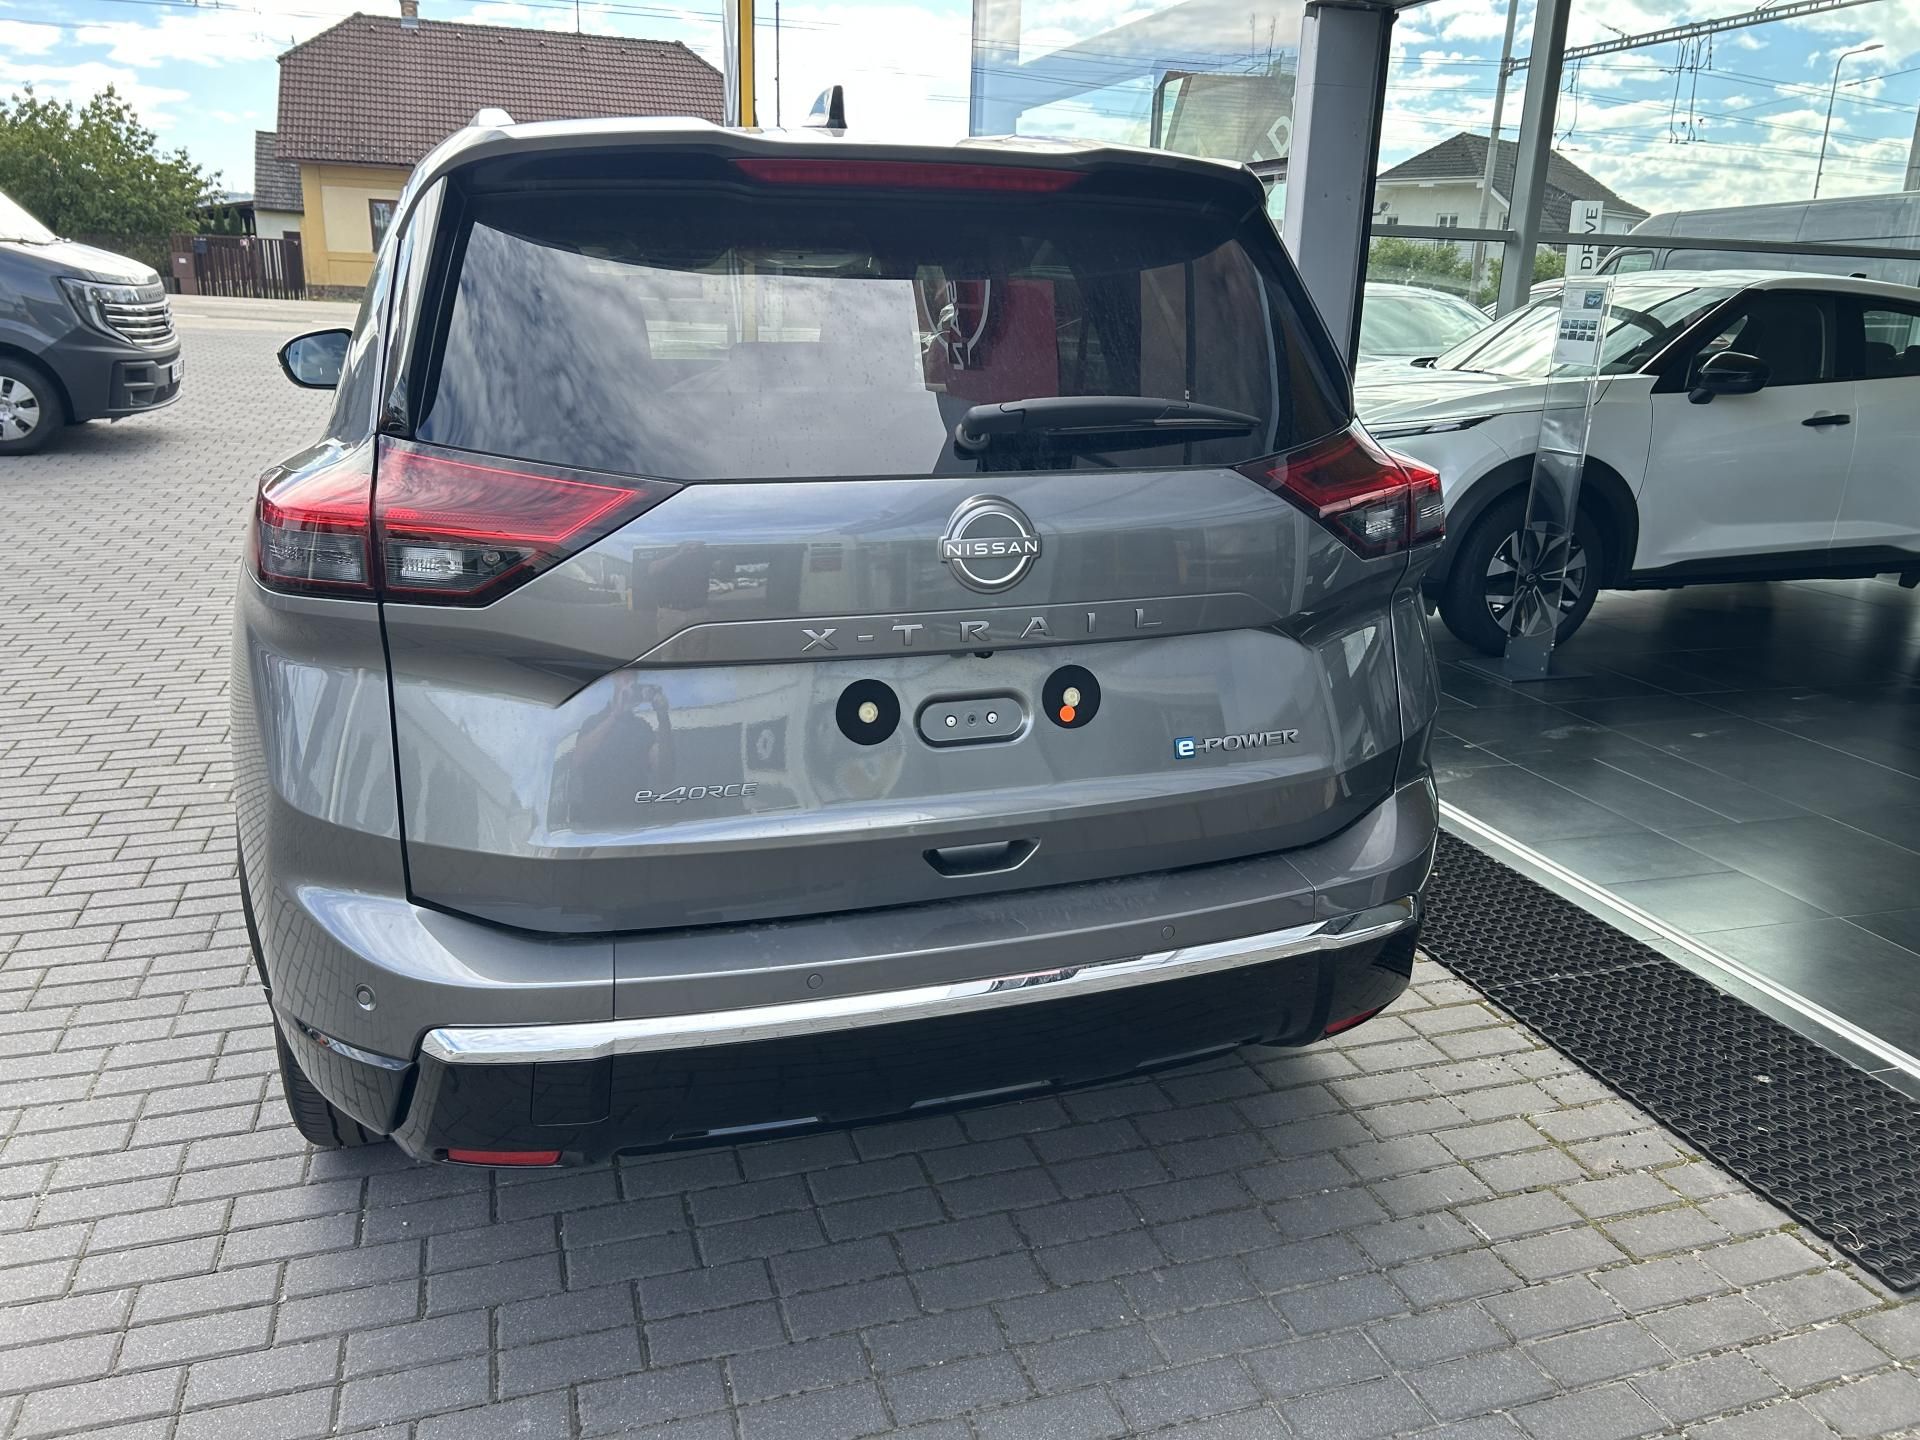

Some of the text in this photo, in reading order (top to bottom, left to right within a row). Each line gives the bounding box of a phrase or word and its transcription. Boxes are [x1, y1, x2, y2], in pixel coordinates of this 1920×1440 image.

[1580, 207, 1598, 270] DRVE
[946, 540, 1038, 556] NISSAN
[801, 608, 1163, 653] X-TRAIL
[1176, 729, 1299, 758] e-POWER
